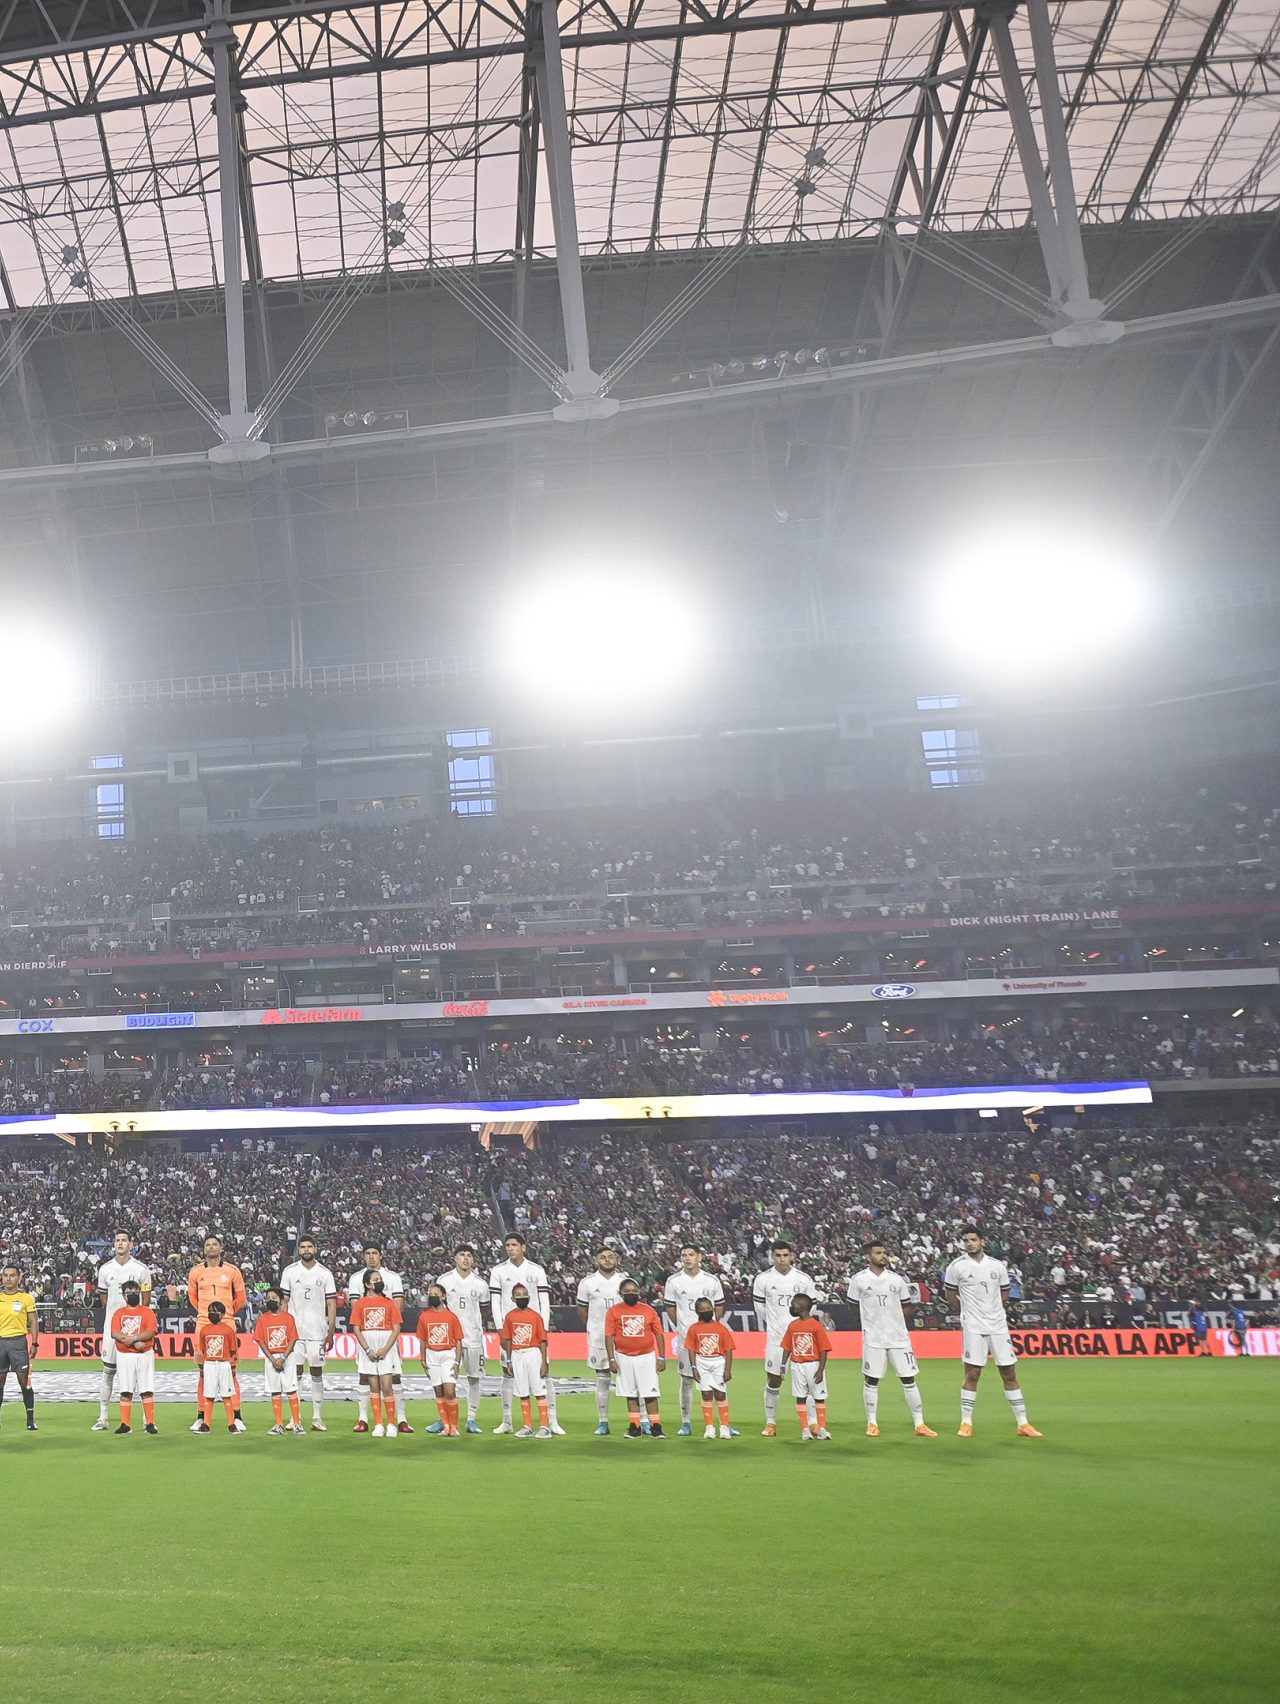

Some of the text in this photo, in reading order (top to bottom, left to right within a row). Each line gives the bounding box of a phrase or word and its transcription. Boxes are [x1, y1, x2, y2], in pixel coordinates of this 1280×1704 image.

[950, 917, 980, 926] DICK
[984, 914, 1030, 925] (NIGHT
[1033, 912, 1080, 922] TRAIN)
[1084, 910, 1119, 919] LANE
[369, 944, 407, 954] LARRY
[410, 942, 457, 952] WILSON
[18, 1020, 54, 1032] COX
[305, 1288, 311, 1300] 2
[980, 1281, 988, 1294] 9
[459, 1297, 466, 1309] 6
[876, 1294, 888, 1307] 17
[1115, 1333, 1148, 1355] LA
[904, 1352, 914, 1365] 17
